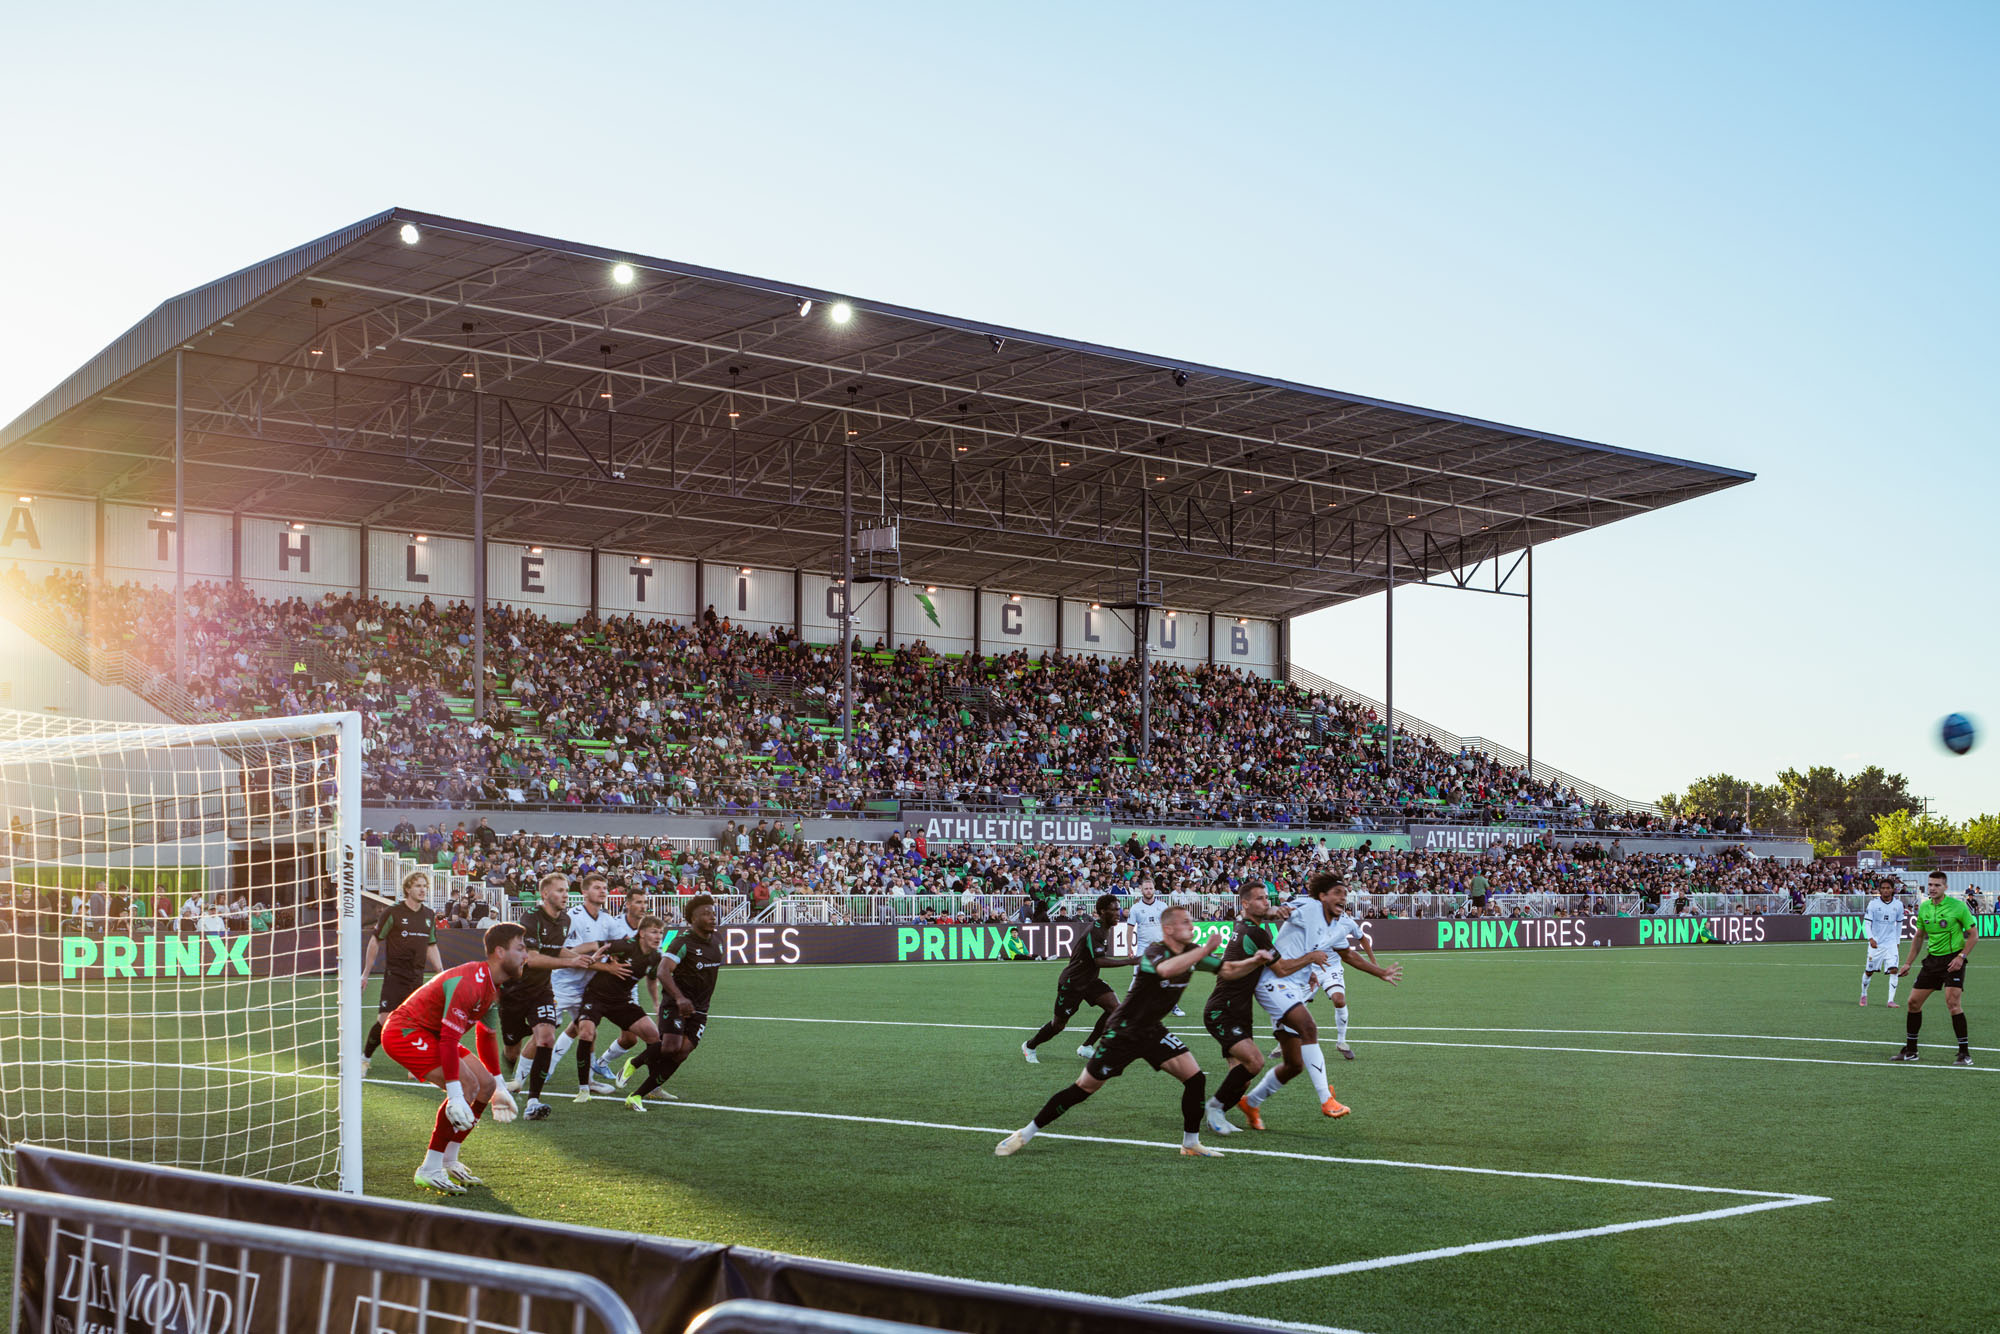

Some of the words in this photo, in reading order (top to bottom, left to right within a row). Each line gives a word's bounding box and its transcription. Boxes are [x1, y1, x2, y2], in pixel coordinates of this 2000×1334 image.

[1001, 603, 1248, 655] CLUB
[926, 818, 1034, 840] ATHLETIC
[1041, 821, 1093, 841] CLUB
[898, 927, 1017, 960] PRINX
[1022, 925, 1074, 958] TIR
[1437, 920, 1518, 949] PRINX
[1522, 919, 1586, 947] TIRES
[1638, 918, 1707, 944] PRINX
[1710, 917, 1765, 942] TIRES
[62, 935, 251, 979] PRINX
[726, 928, 801, 964] RES
[537, 1004, 556, 1018] 25
[1160, 1032, 1184, 1049] 16
